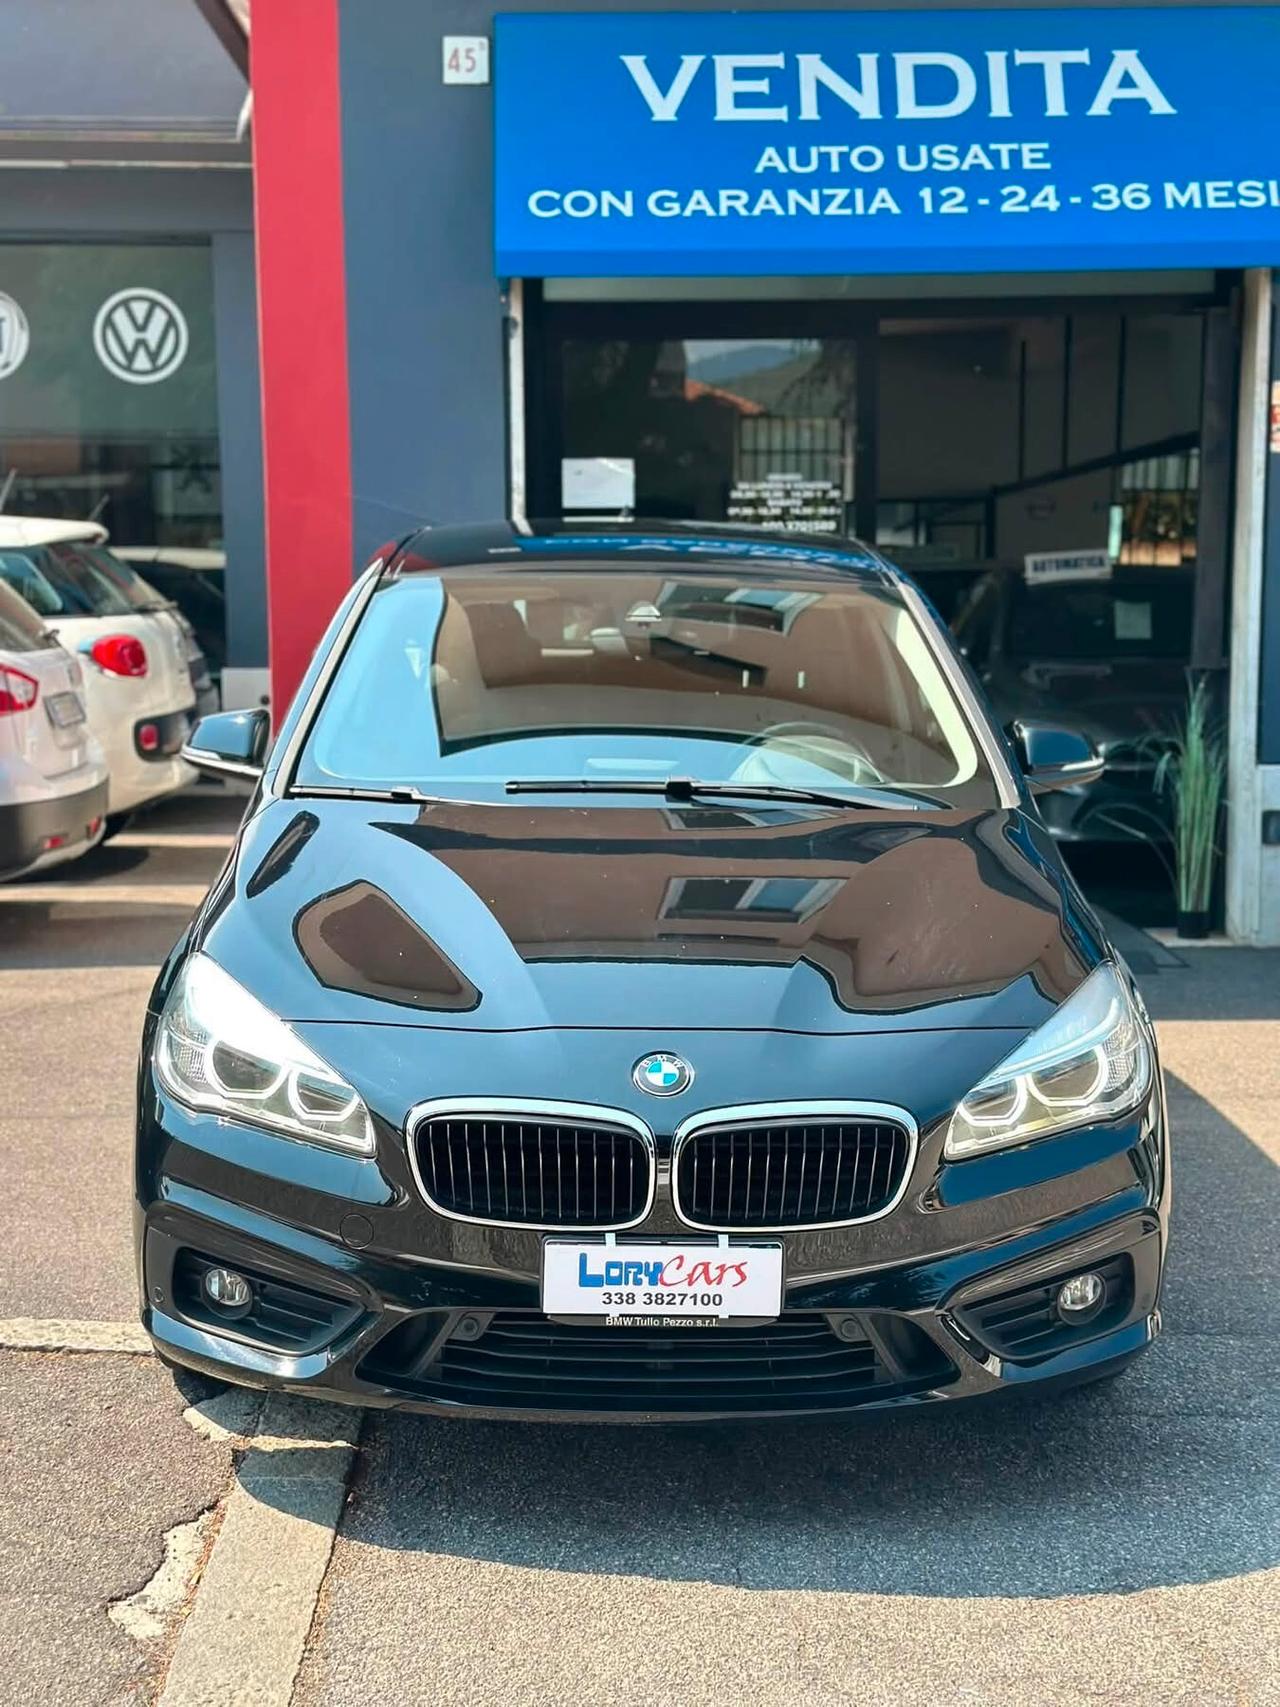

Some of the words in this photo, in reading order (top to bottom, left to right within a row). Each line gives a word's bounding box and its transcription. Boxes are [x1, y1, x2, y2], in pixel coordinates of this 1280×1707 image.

[621, 49, 1177, 122] VENDITA
[755, 145, 885, 174] AUTO
[897, 142, 1052, 173] USATE
[528, 189, 634, 219] CON
[646, 188, 901, 218] GARANZIA
[919, 186, 969, 214] 12
[1001, 185, 1061, 213] 24
[1092, 182, 1152, 212] 36
[1163, 178, 1280, 210] MESI
[601, 1292, 636, 1305] 338
[642, 1292, 723, 1307] 3827100
[605, 1316, 632, 1327] BMW
[635, 1316, 660, 1327] Tullo
[663, 1317, 694, 1328] Pezzo
